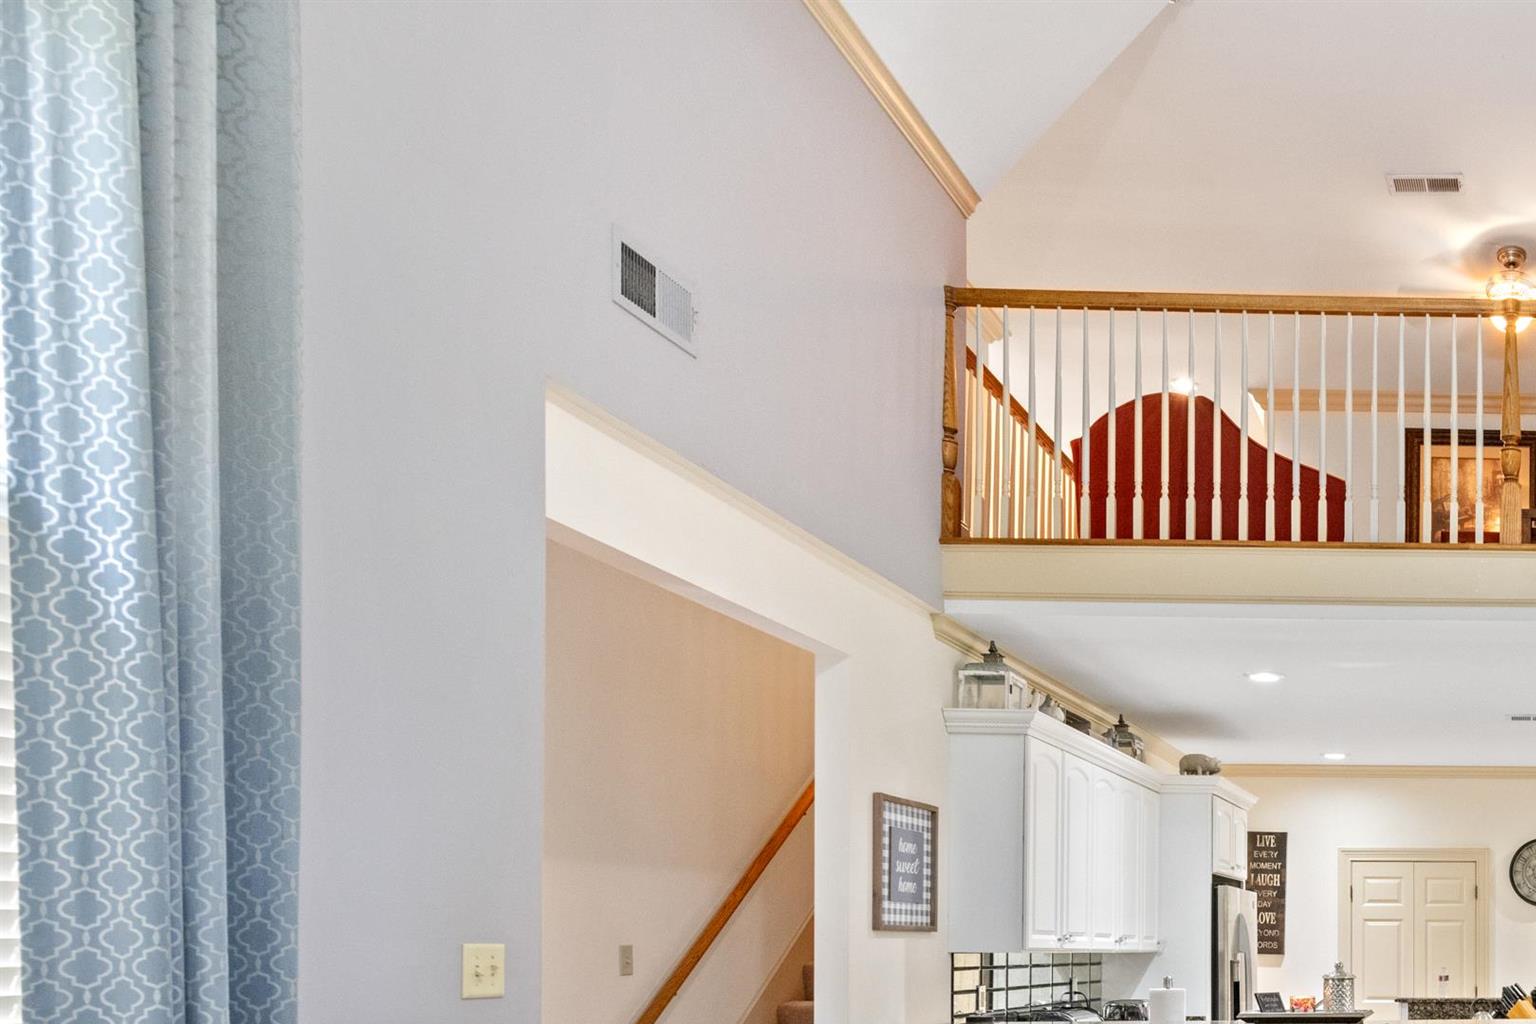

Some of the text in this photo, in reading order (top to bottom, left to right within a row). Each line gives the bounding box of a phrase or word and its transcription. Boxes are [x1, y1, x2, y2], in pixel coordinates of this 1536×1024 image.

[898, 836, 918, 854] home
[1256, 834, 1277, 848] LIVE
[1253, 850, 1279, 858] EVERY
[896, 858, 920, 874] sweet
[1250, 861, 1282, 870] MOMENT
[898, 876, 918, 894] home
[1250, 873, 1281, 887] LAUGH
[1257, 890, 1278, 898] VERY
[1258, 911, 1277, 925] OVE
[1258, 929, 1280, 937] YOND
[1257, 940, 1279, 949] ORDS
